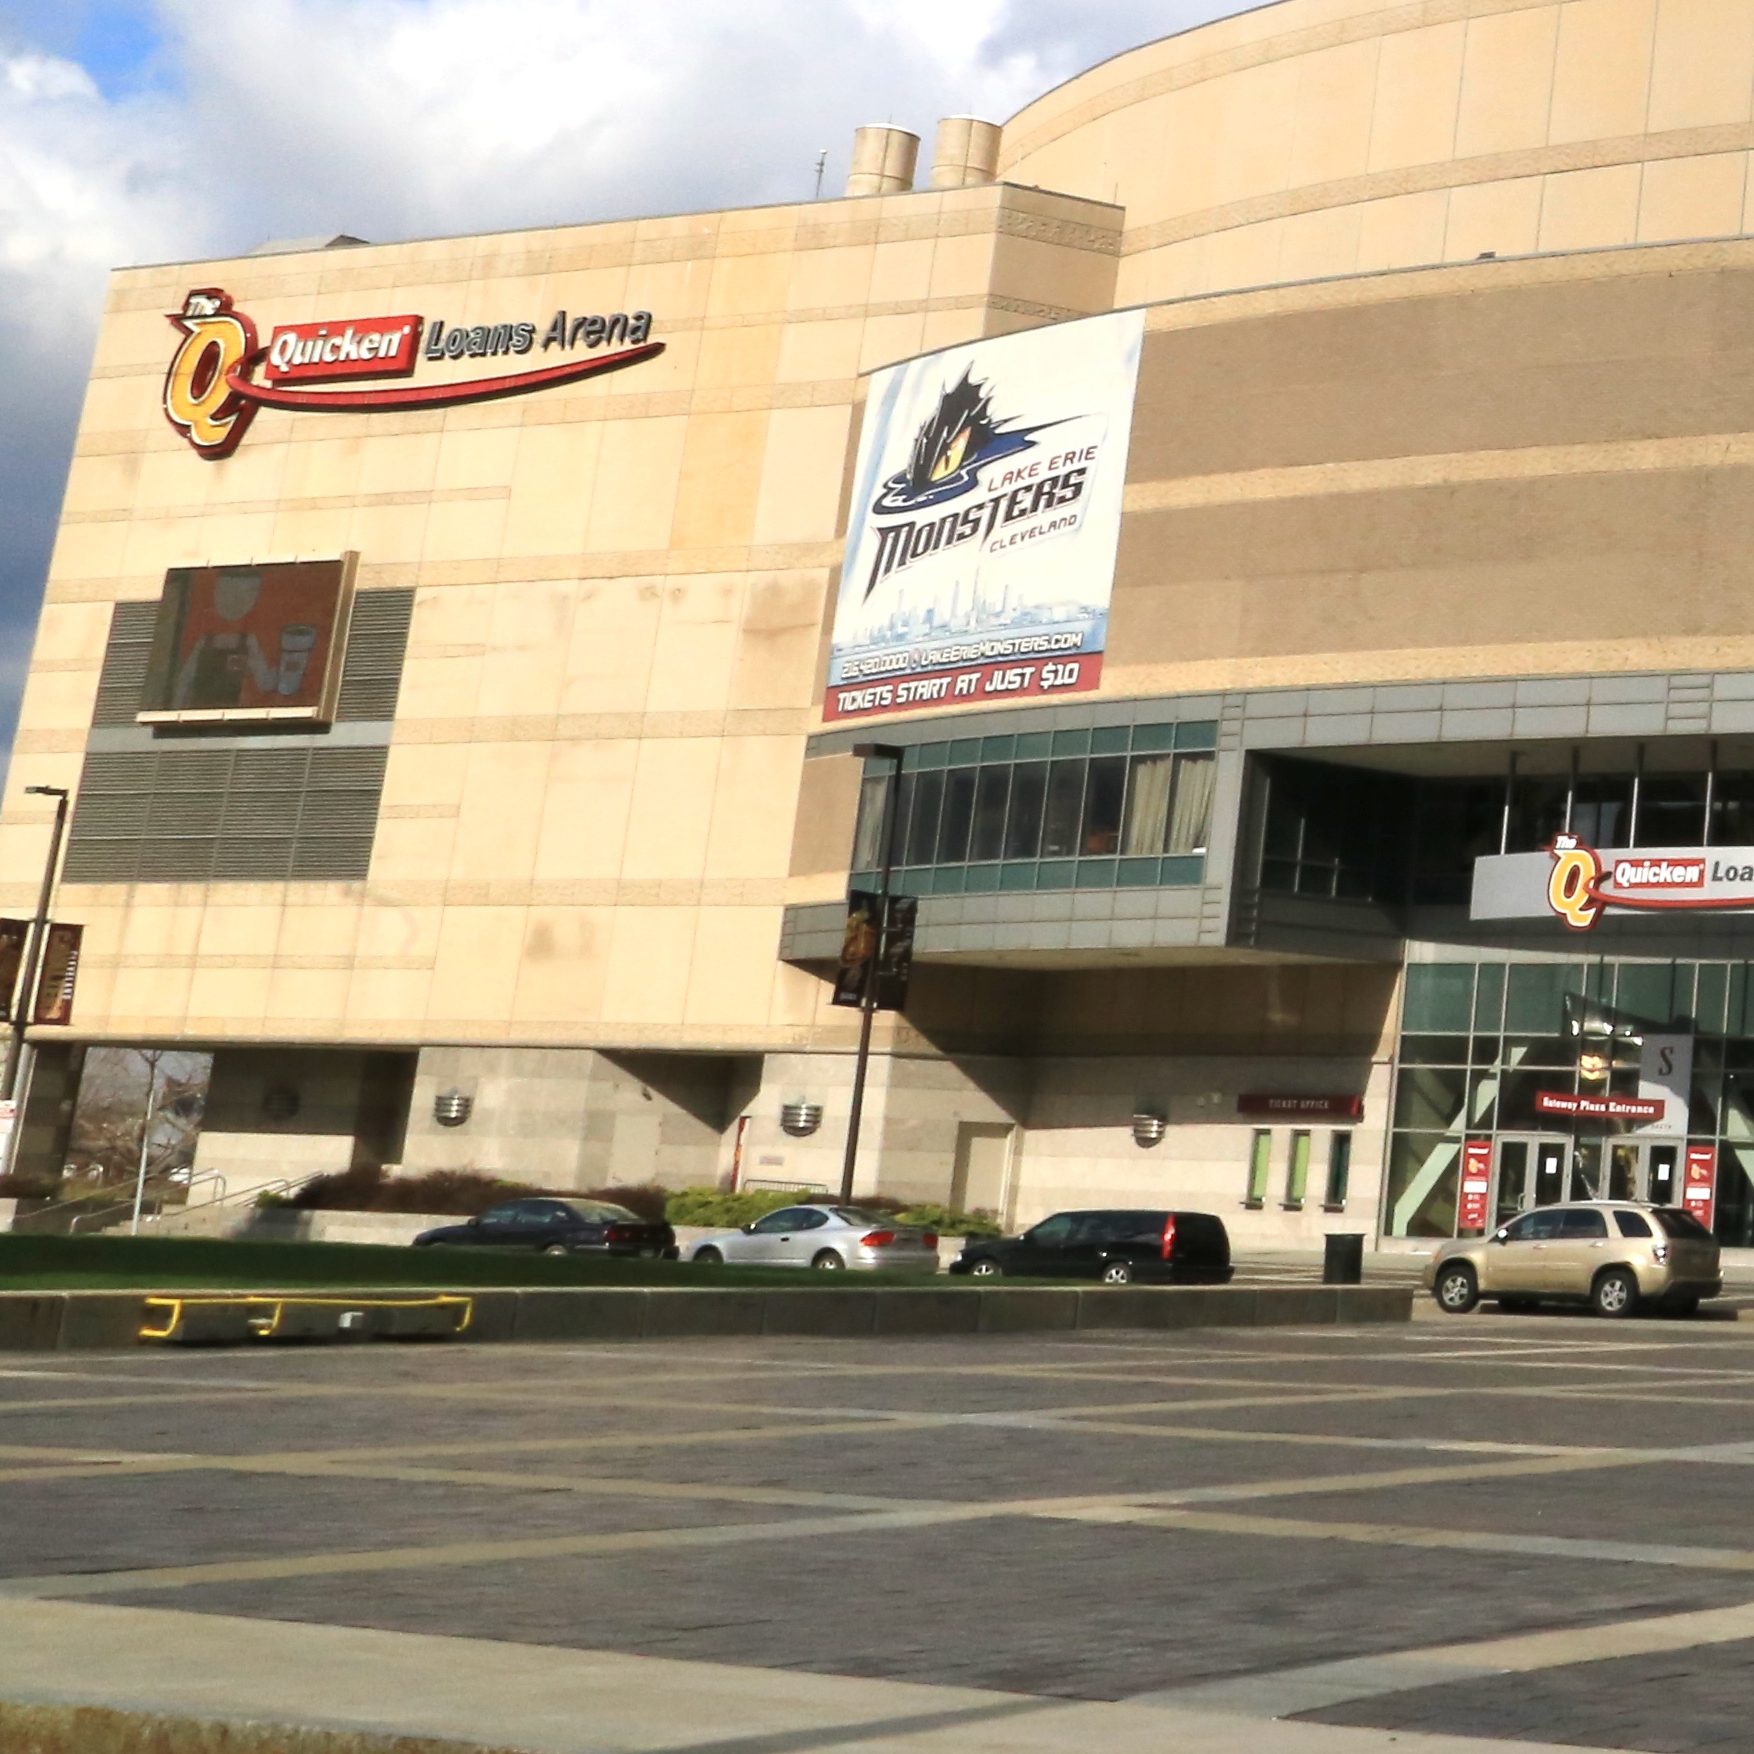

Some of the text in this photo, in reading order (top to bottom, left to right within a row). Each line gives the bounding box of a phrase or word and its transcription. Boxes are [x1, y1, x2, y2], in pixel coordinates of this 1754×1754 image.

[184, 295, 222, 316] The
[424, 319, 536, 360] Loans
[542, 309, 653, 355] Arena
[166, 316, 246, 446] Q
[987, 445, 1098, 493] LAKE ERIE
[989, 513, 1078, 553] CLEVELAND
[838, 661, 1080, 712] TICKETS START AT JUST $10
[1555, 834, 1578, 849] The
[1549, 849, 1597, 927] Q
[1658, 1046, 1674, 1077] S
[1542, 1096, 1655, 1114] Gateway Plaza Entrance
